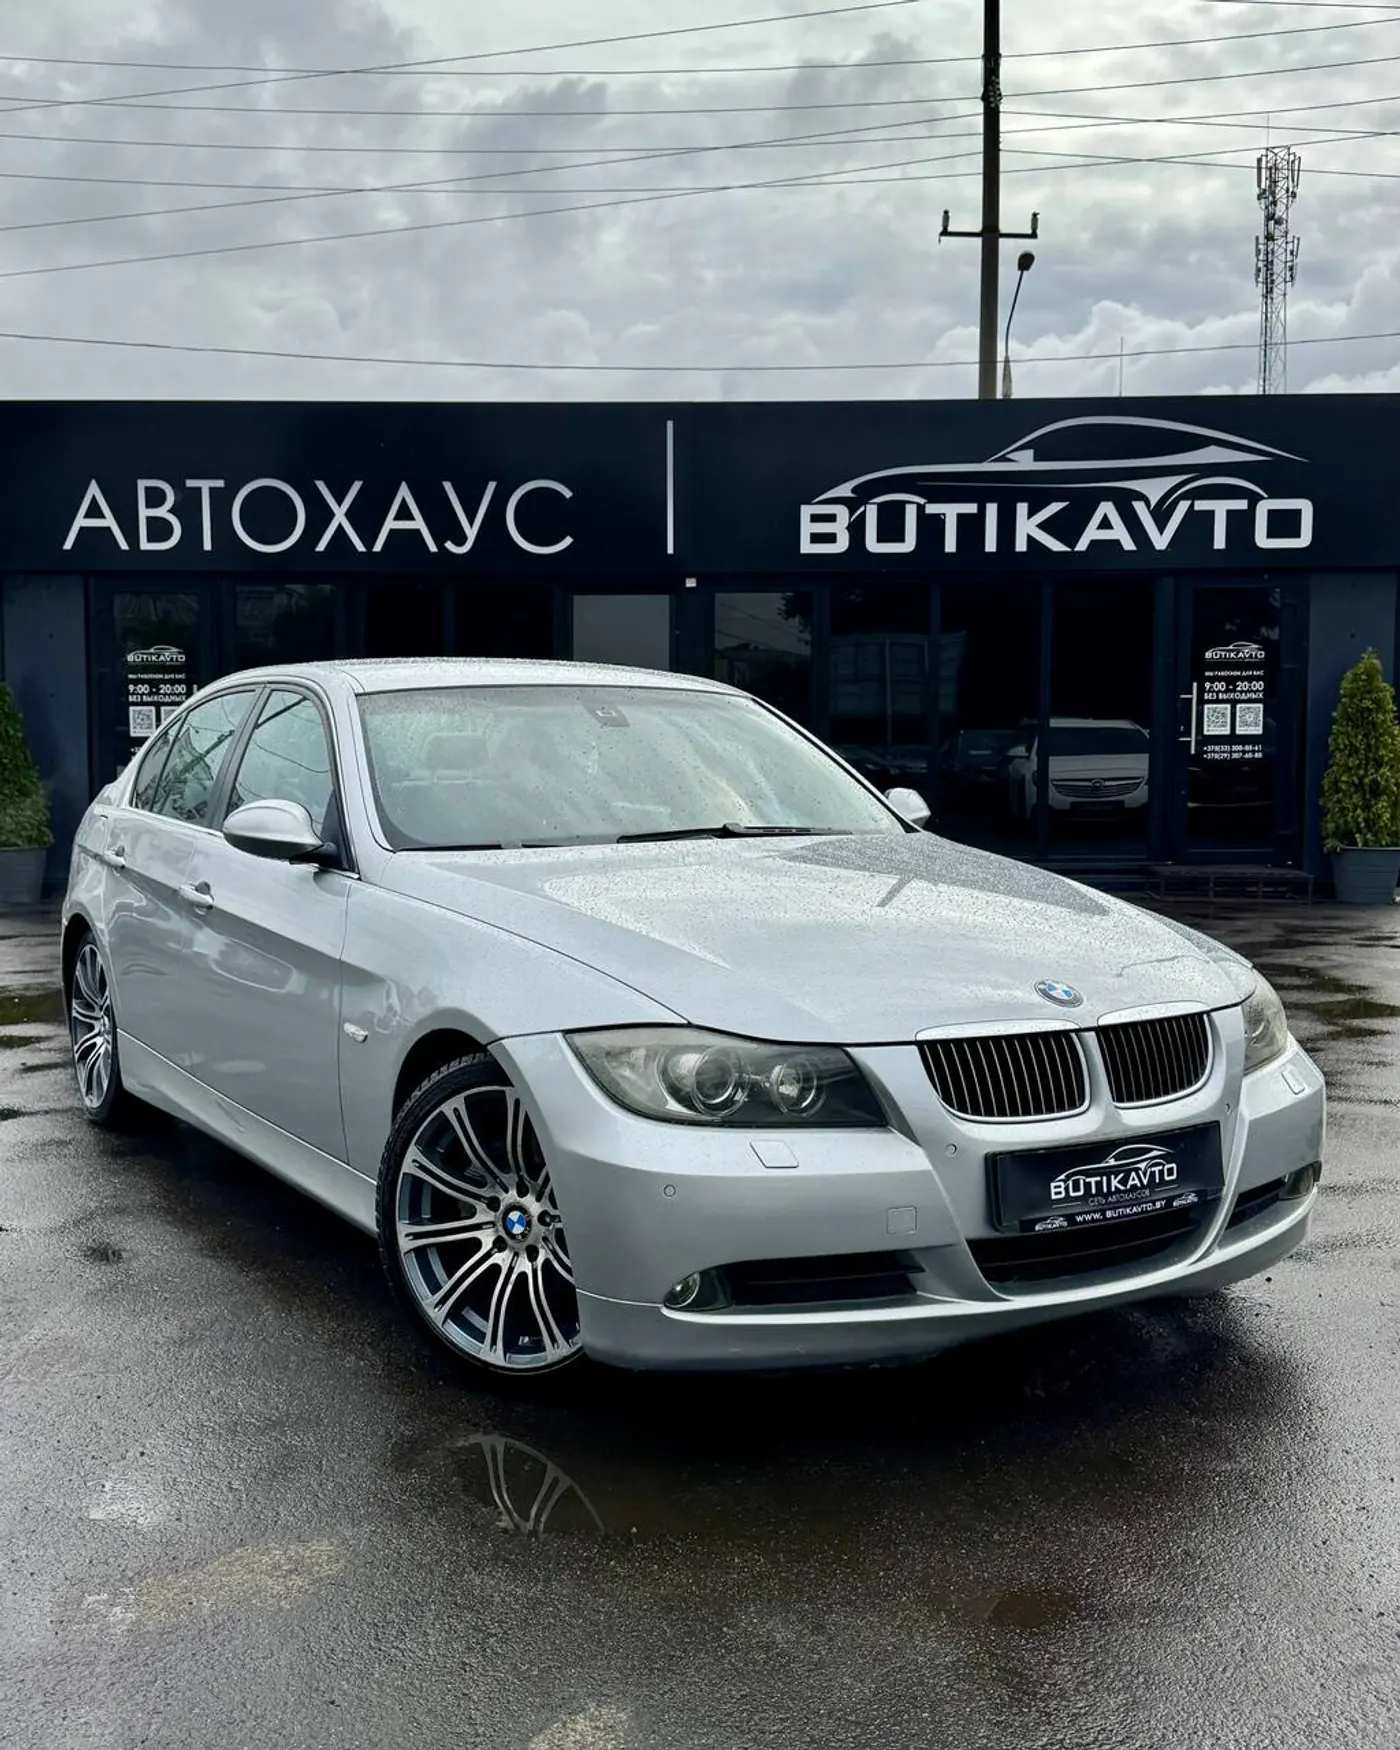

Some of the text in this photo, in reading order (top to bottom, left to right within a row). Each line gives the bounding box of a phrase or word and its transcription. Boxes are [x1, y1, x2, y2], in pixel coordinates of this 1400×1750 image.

[63, 478, 574, 555] АВТОХАУС
[800, 498, 1314, 554] BUTIKAVTO
[127, 654, 186, 662] BUTIKAVTO
[1204, 650, 1266, 659] BUTIKAVTO
[128, 684, 150, 694] 9:00
[159, 684, 187, 694] 20:00
[1204, 681, 1226, 691] 9:00
[1235, 681, 1264, 691] 20:00
[1204, 691, 1264, 700] БЕЗ ВЫХОДНЫХ
[1050, 1163, 1177, 1199] BUTIKAVTO
[1075, 1200, 1166, 1222] WWW. BUTIKAVTO.BY
